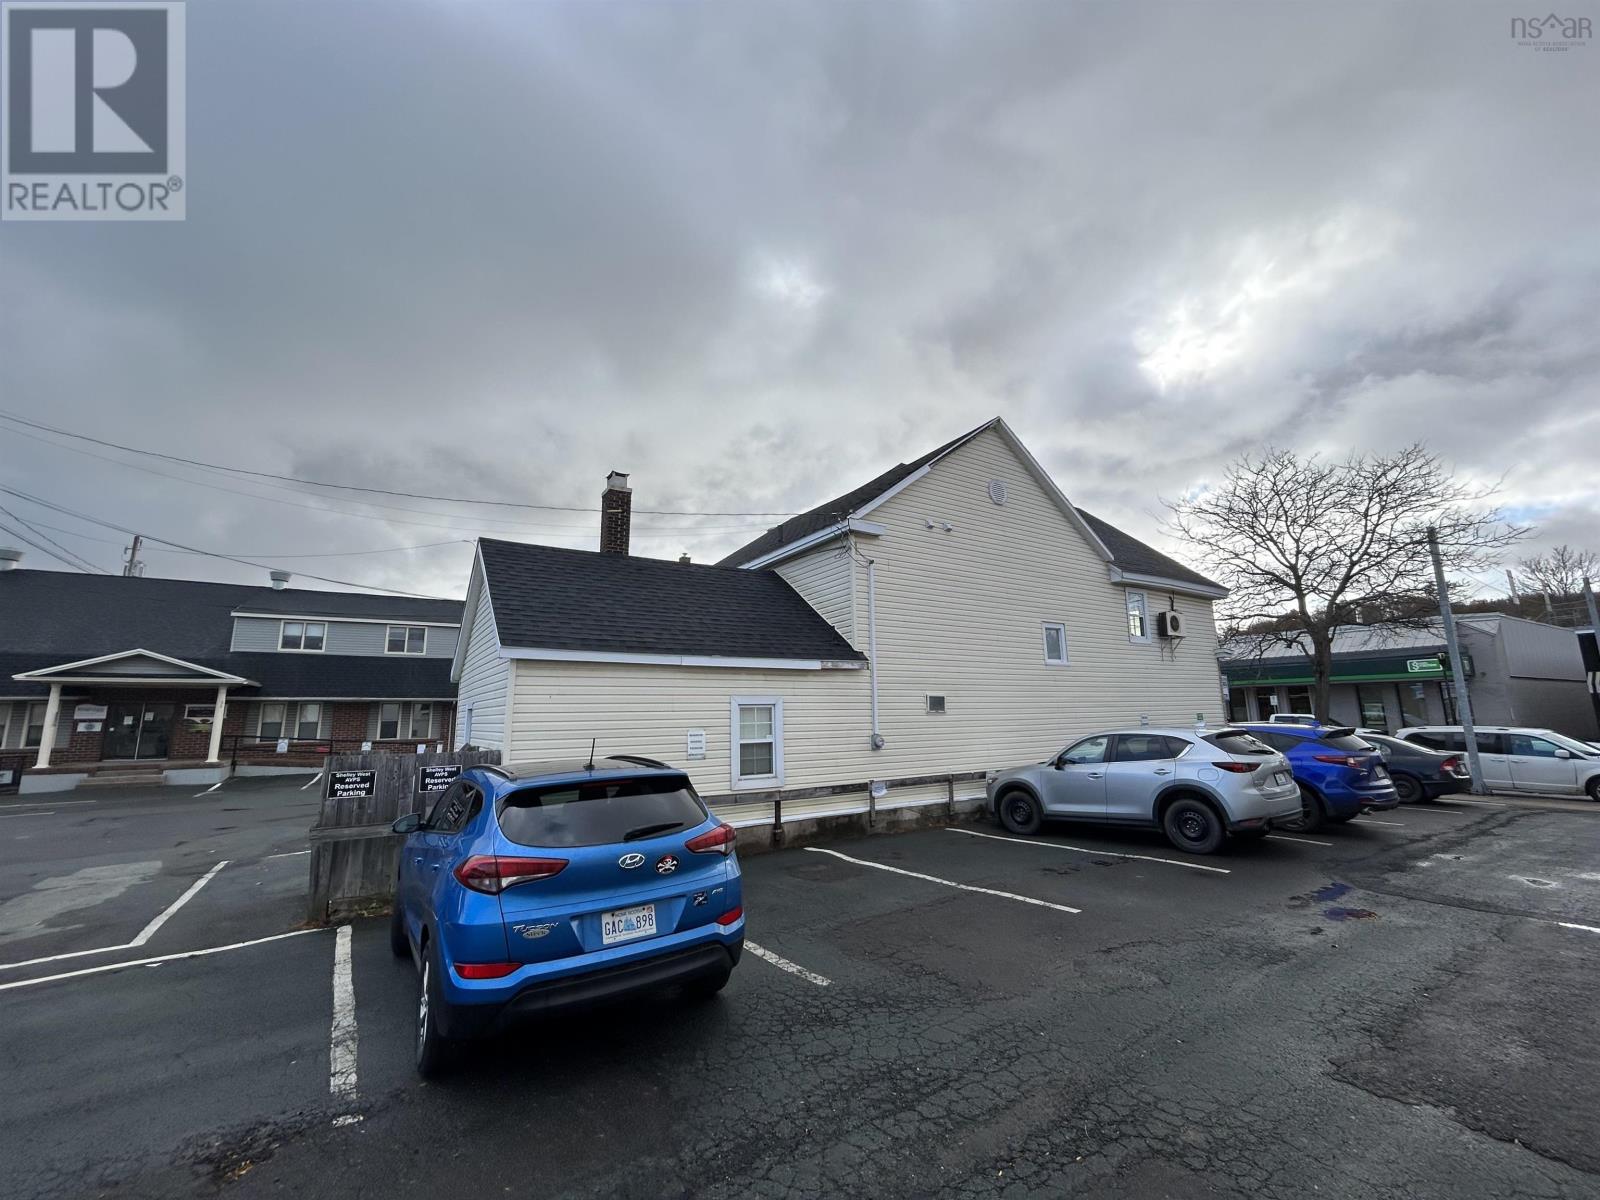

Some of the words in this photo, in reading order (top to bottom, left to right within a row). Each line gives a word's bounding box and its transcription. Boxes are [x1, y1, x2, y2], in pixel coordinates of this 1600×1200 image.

[334, 781, 370, 789] Reserved
[336, 789, 366, 797] Parking
[604, 919, 624, 936] GAC
[635, 913, 654, 929] 898
